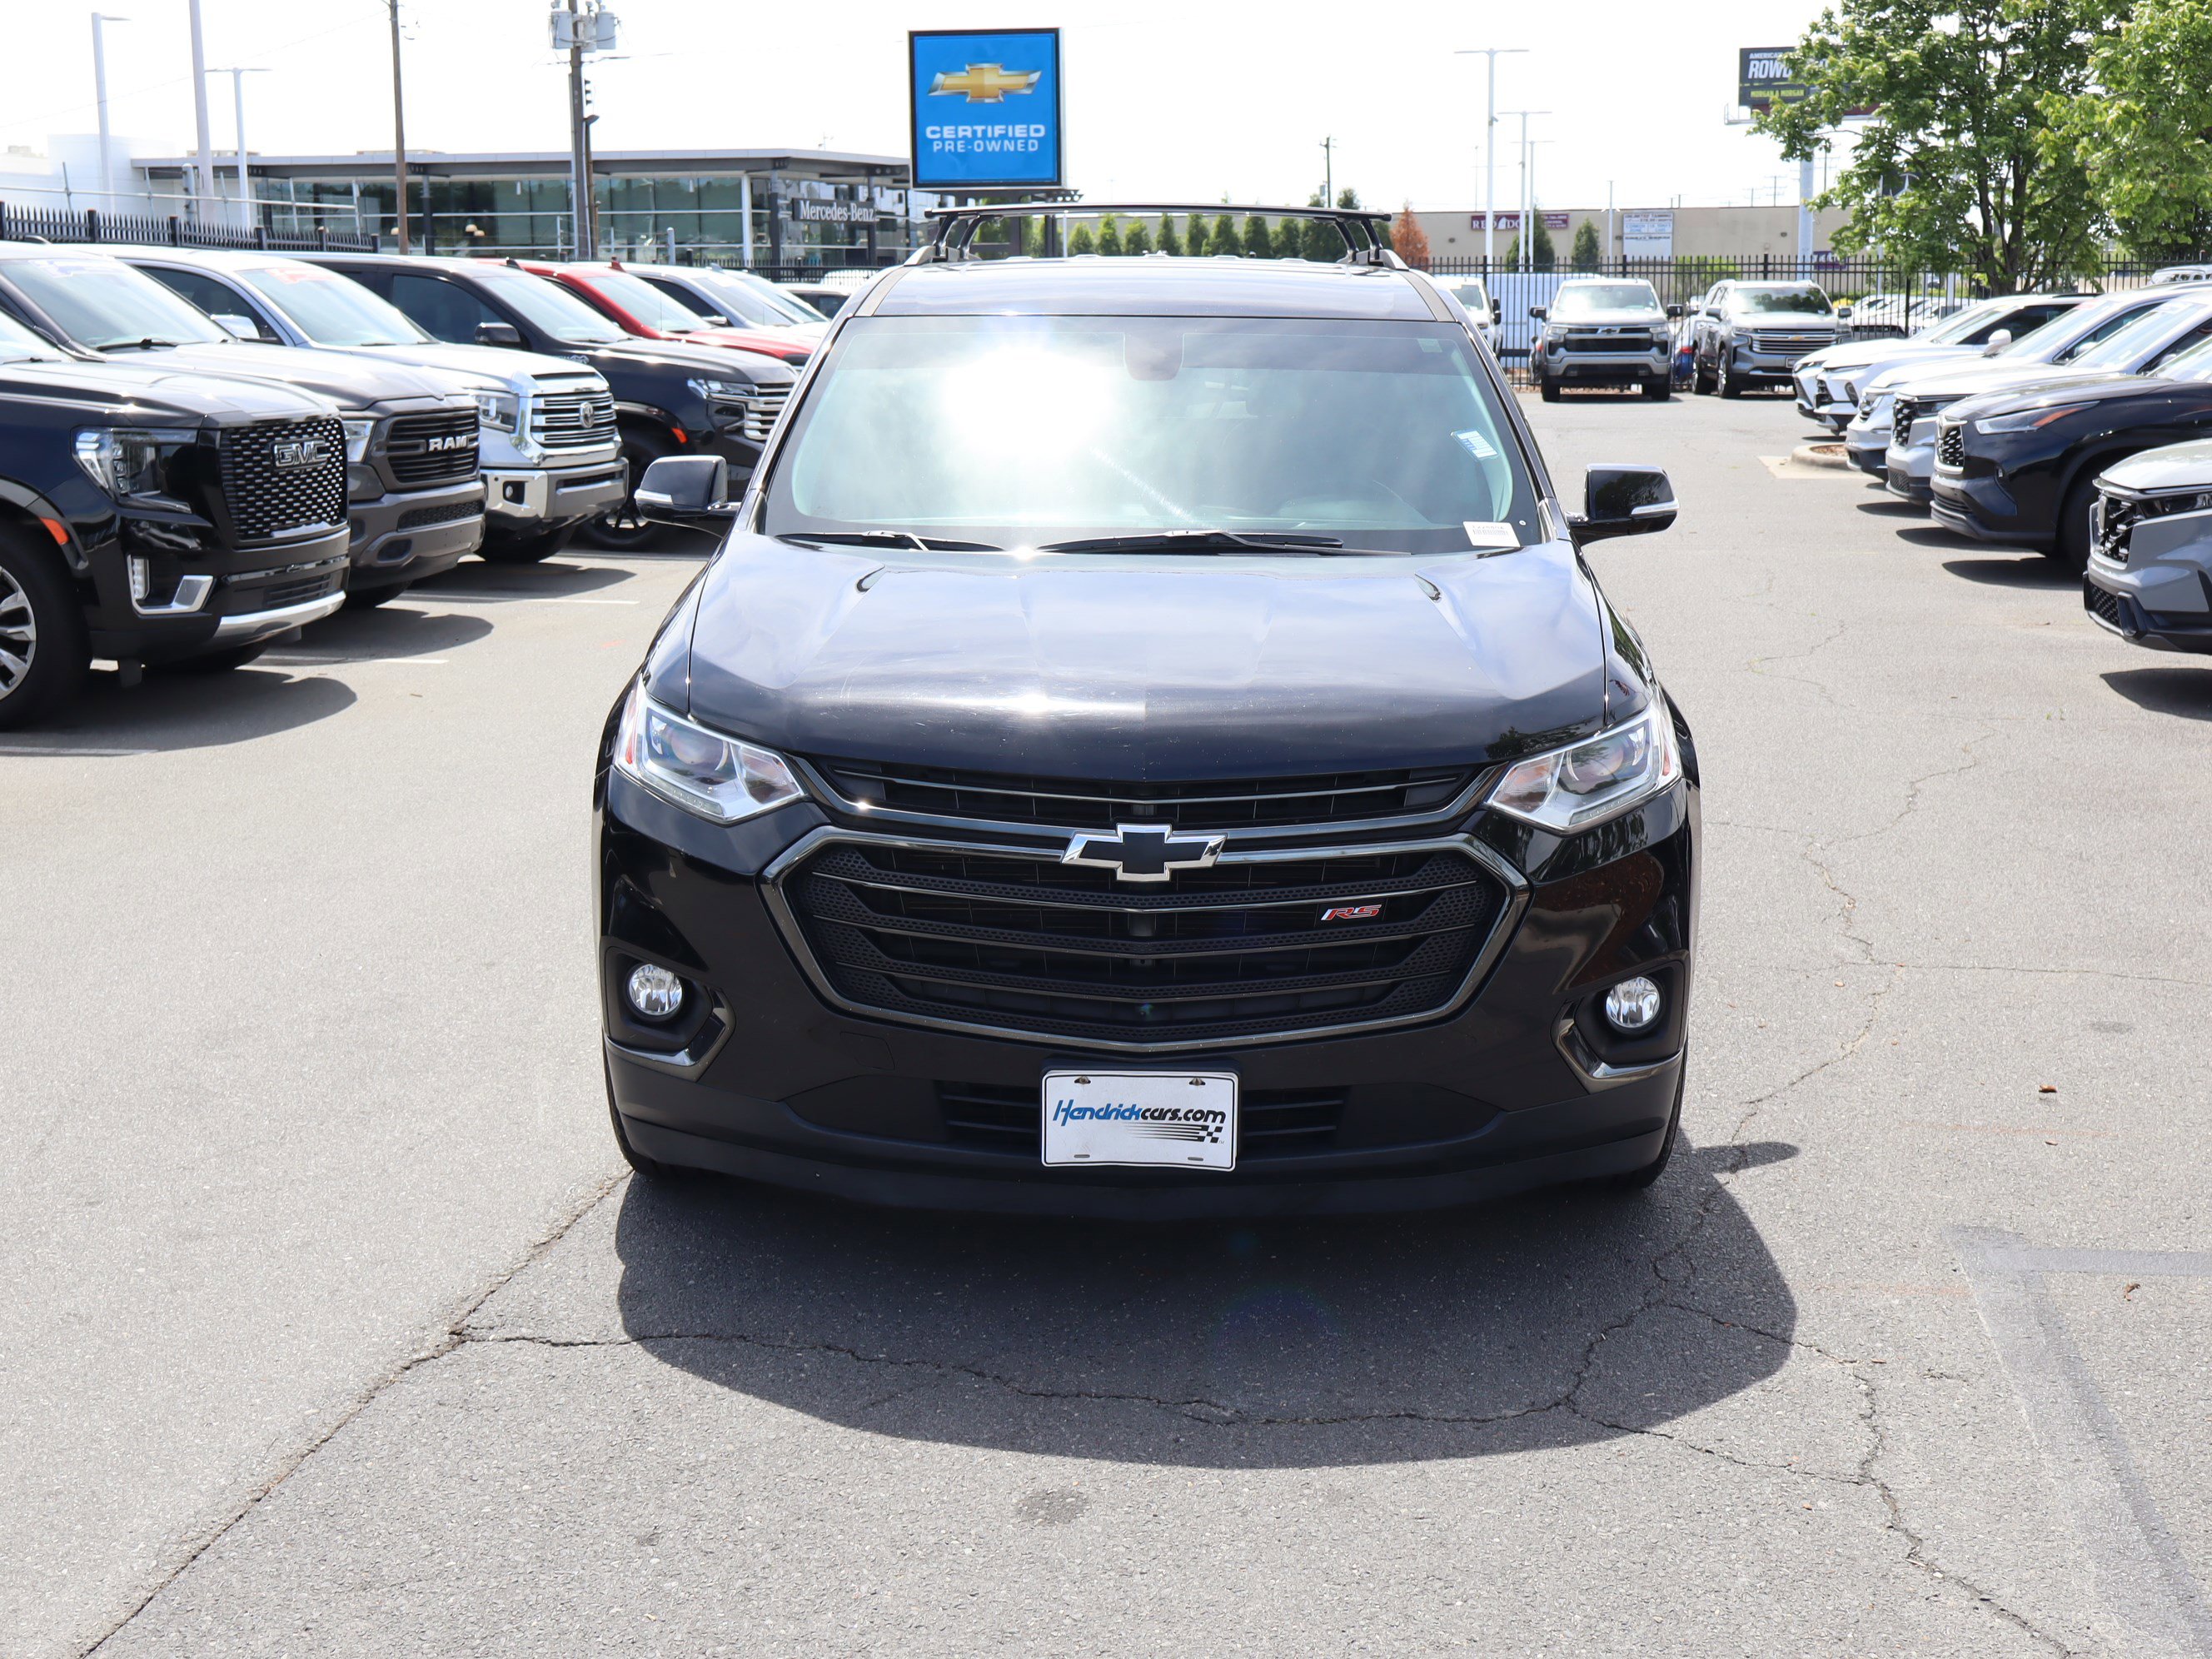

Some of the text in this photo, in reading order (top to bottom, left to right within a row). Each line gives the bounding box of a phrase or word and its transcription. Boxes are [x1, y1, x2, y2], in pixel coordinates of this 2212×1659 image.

[925, 124, 1045, 139] CERTIFIED
[933, 139, 1039, 152] PRE-OWNED
[800, 200, 875, 222] Mercedes-Benz
[428, 436, 467, 452] RAM
[276, 440, 331, 468] GMC
[1321, 904, 1382, 921] RS
[1053, 1099, 1227, 1127] Hendrickcars.com
